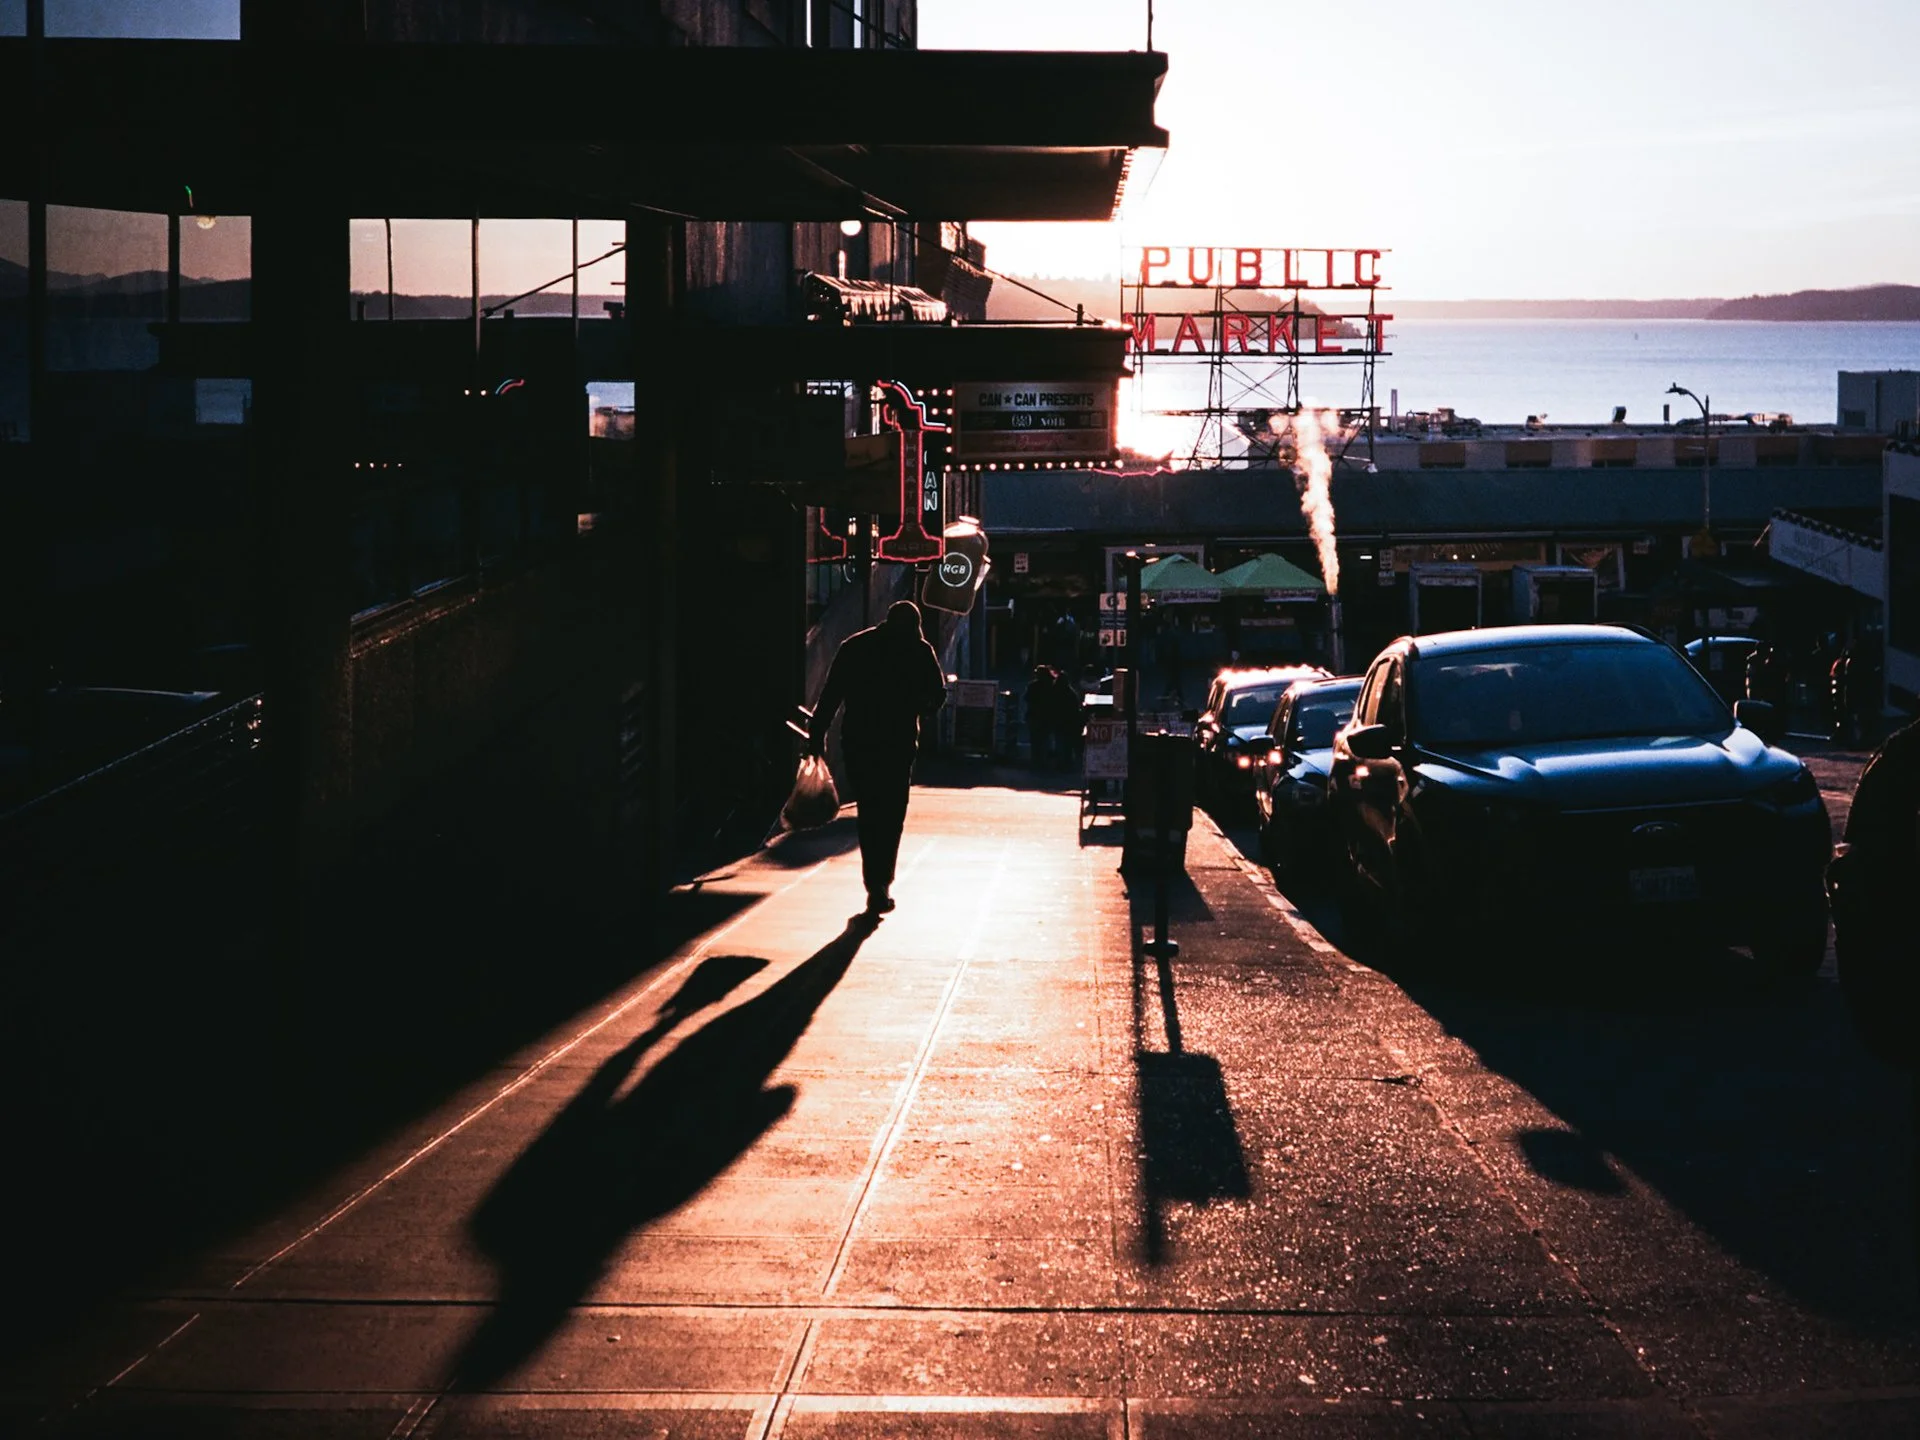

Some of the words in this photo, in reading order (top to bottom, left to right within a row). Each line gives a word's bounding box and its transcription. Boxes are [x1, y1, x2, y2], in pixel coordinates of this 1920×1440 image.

[1142, 247, 1382, 286] PUBLIC
[1125, 313, 1394, 353] MARKET
[979, 393, 1002, 406] CAN
[1014, 393, 1037, 406] CAN
[1039, 393, 1094, 406] PRESENTS
[943, 563, 967, 575] RGB
